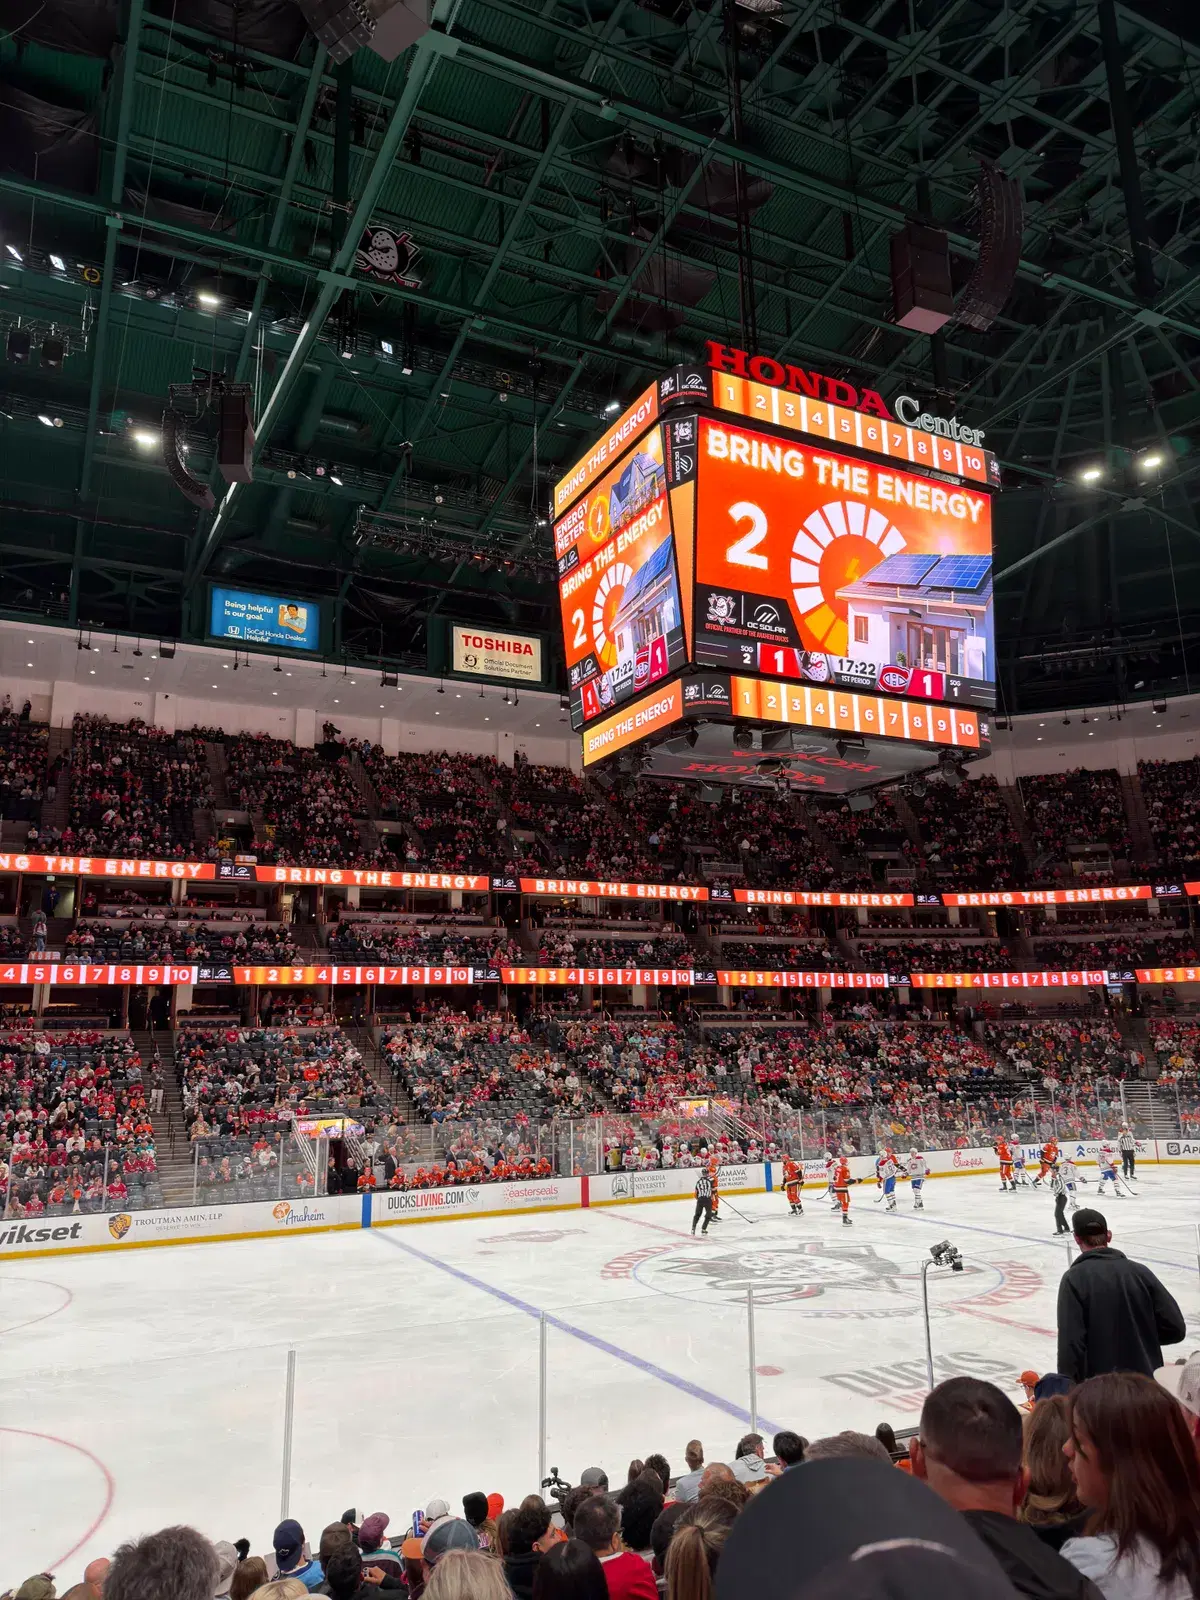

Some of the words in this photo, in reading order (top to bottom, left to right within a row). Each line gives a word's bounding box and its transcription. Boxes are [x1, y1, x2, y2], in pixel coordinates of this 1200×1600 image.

[704, 340, 894, 420] HONDA
[895, 395, 985, 448] Center
[726, 386, 735, 401] 1
[756, 395, 767, 410] 2
[784, 403, 795, 417] 3
[812, 412, 823, 425] 4
[840, 419, 851, 433] 5
[867, 426, 877, 441] 6
[892, 434, 903, 447] 7
[918, 441, 927, 454] 8
[942, 449, 952, 462] 9
[966, 455, 981, 471] 10
[558, 470, 585, 504] BRING
[587, 447, 606, 473] THE
[608, 397, 653, 454] ENERGY
[707, 428, 804, 478] BRING
[814, 456, 869, 496] THE
[878, 476, 984, 523] ENERGY
[556, 500, 589, 538] ENERGY
[557, 521, 585, 554] METER
[726, 501, 768, 570] 2
[562, 564, 592, 599] BRING
[594, 544, 615, 573] THE
[617, 500, 664, 554] ENERGY
[225, 600, 246, 610] Being
[248, 604, 273, 614] helpful
[247, 628, 264, 636] SoCal
[265, 629, 284, 638] Honda
[285, 633, 307, 642] Dealers
[571, 608, 587, 649] 2
[705, 623, 723, 632] OFFICIAL
[724, 626, 742, 634] PARTNER
[759, 624, 786, 634] SOLAR
[462, 635, 533, 656] TOSHIBA
[656, 646, 662, 664] 1
[505, 660, 533, 670] Document
[743, 653, 751, 664] 2
[774, 650, 784, 673] 1
[838, 659, 876, 676] 17:22
[612, 660, 633, 682] 17:22
[851, 676, 870, 685] PERIOD
[923, 674, 932, 696] 1
[953, 688, 958, 696] 1
[587, 690, 592, 705] 1
[743, 692, 750, 705] 1
[767, 696, 776, 708] 2
[792, 699, 801, 711] 3
[814, 702, 825, 715] 4
[840, 706, 848, 718] 5
[864, 709, 874, 721] 6
[889, 713, 898, 725] 7
[912, 716, 922, 728] 8
[938, 720, 946, 731] 9
[959, 723, 974, 735] 10
[589, 731, 614, 752] BRING
[616, 720, 633, 737] THE
[636, 695, 674, 727] ENERGY
[44, 856, 91, 873] THE
[105, 859, 201, 877] ENERGY
[275, 869, 342, 883] BRING
[354, 871, 392, 884] THE
[402, 874, 478, 889] ENERGY
[536, 880, 590, 893] BRING
[598, 884, 629, 896] THE
[637, 885, 700, 899] ENERGY
[747, 892, 792, 903] BRING
[802, 894, 832, 904] THE
[840, 894, 903, 905] ENERGY
[957, 893, 1012, 905] BRING
[1022, 892, 1056, 903] THE
[1065, 887, 1140, 902] ENERGY
[3, 968, 15, 980] 4
[34, 968, 44, 980] 5
[63, 969, 74, 980] 6
[93, 969, 103, 980] 7
[120, 969, 131, 980] 8
[148, 969, 159, 981] 9
[172, 969, 190, 981] 10
[243, 970, 250, 981] 1
[268, 970, 277, 981] 2
[293, 970, 303, 981] 3
[318, 970, 328, 981] 4
[342, 970, 351, 981] 5
[365, 970, 375, 981] 6
[389, 970, 398, 981] 7
[411, 970, 420, 981] 8
[433, 970, 442, 981] 9
[452, 970, 467, 981] 10
[509, 971, 515, 980] 1
[528, 971, 537, 980] 2
[548, 971, 557, 980] 3
[567, 971, 576, 980] 4
[587, 971, 595, 981] 5
[606, 971, 614, 981] 6
[625, 972, 633, 982] 7
[643, 972, 651, 982] 8
[661, 972, 669, 982] 9
[676, 972, 689, 982] 10
[1144, 972, 1151, 981] 1
[1165, 971, 1174, 980] 2
[1186, 970, 1196, 979] 3
[388, 1191, 464, 1210] DUCKSLIVING.COM
[509, 1185, 558, 1198] easterseals
[135, 1216, 182, 1226] TROUTMAN
[183, 1214, 207, 1222] AMIN,
[286, 1206, 324, 1225] Anaheim
[820, 1352, 1018, 1398] DUCKS
